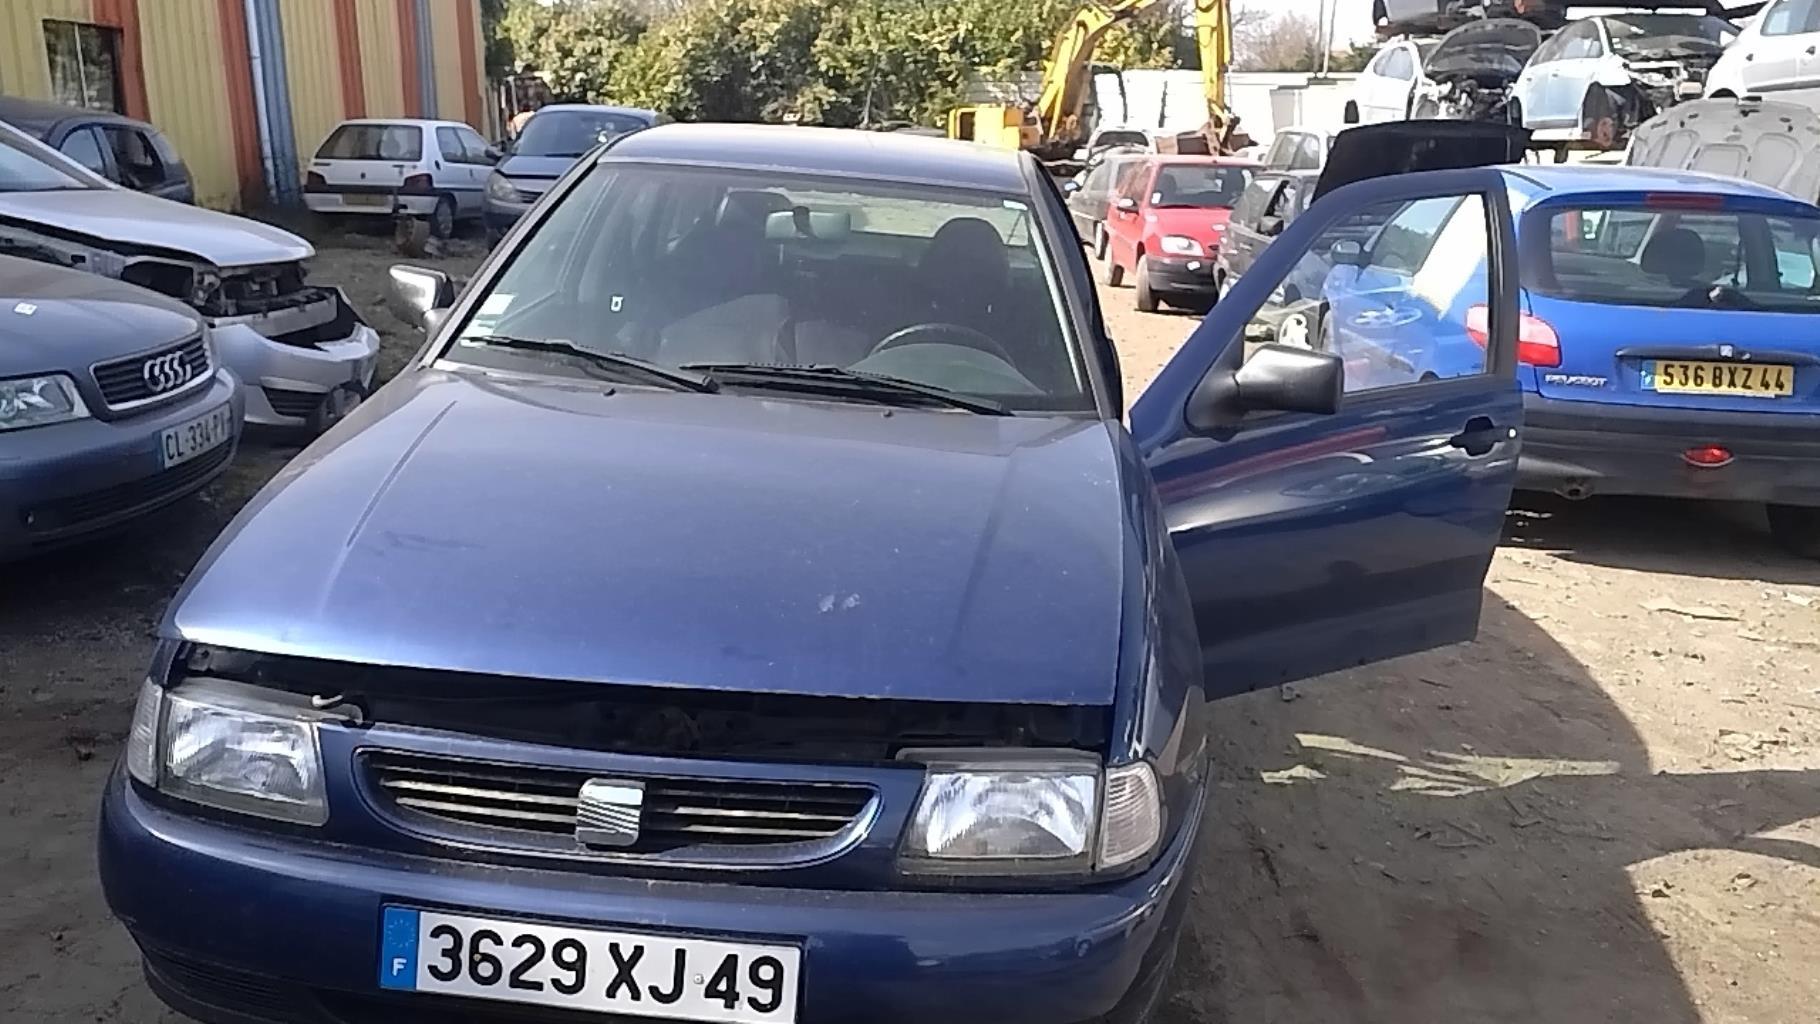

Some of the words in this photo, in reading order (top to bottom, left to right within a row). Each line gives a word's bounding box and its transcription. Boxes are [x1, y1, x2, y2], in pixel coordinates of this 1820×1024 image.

[1662, 364, 1704, 387] 536
[1711, 366, 1752, 389] BXZ
[1759, 367, 1785, 391] 44
[392, 958, 408, 977] F
[427, 924, 588, 995] 3629
[605, 942, 687, 1004] XJ
[703, 953, 785, 1014] 49
